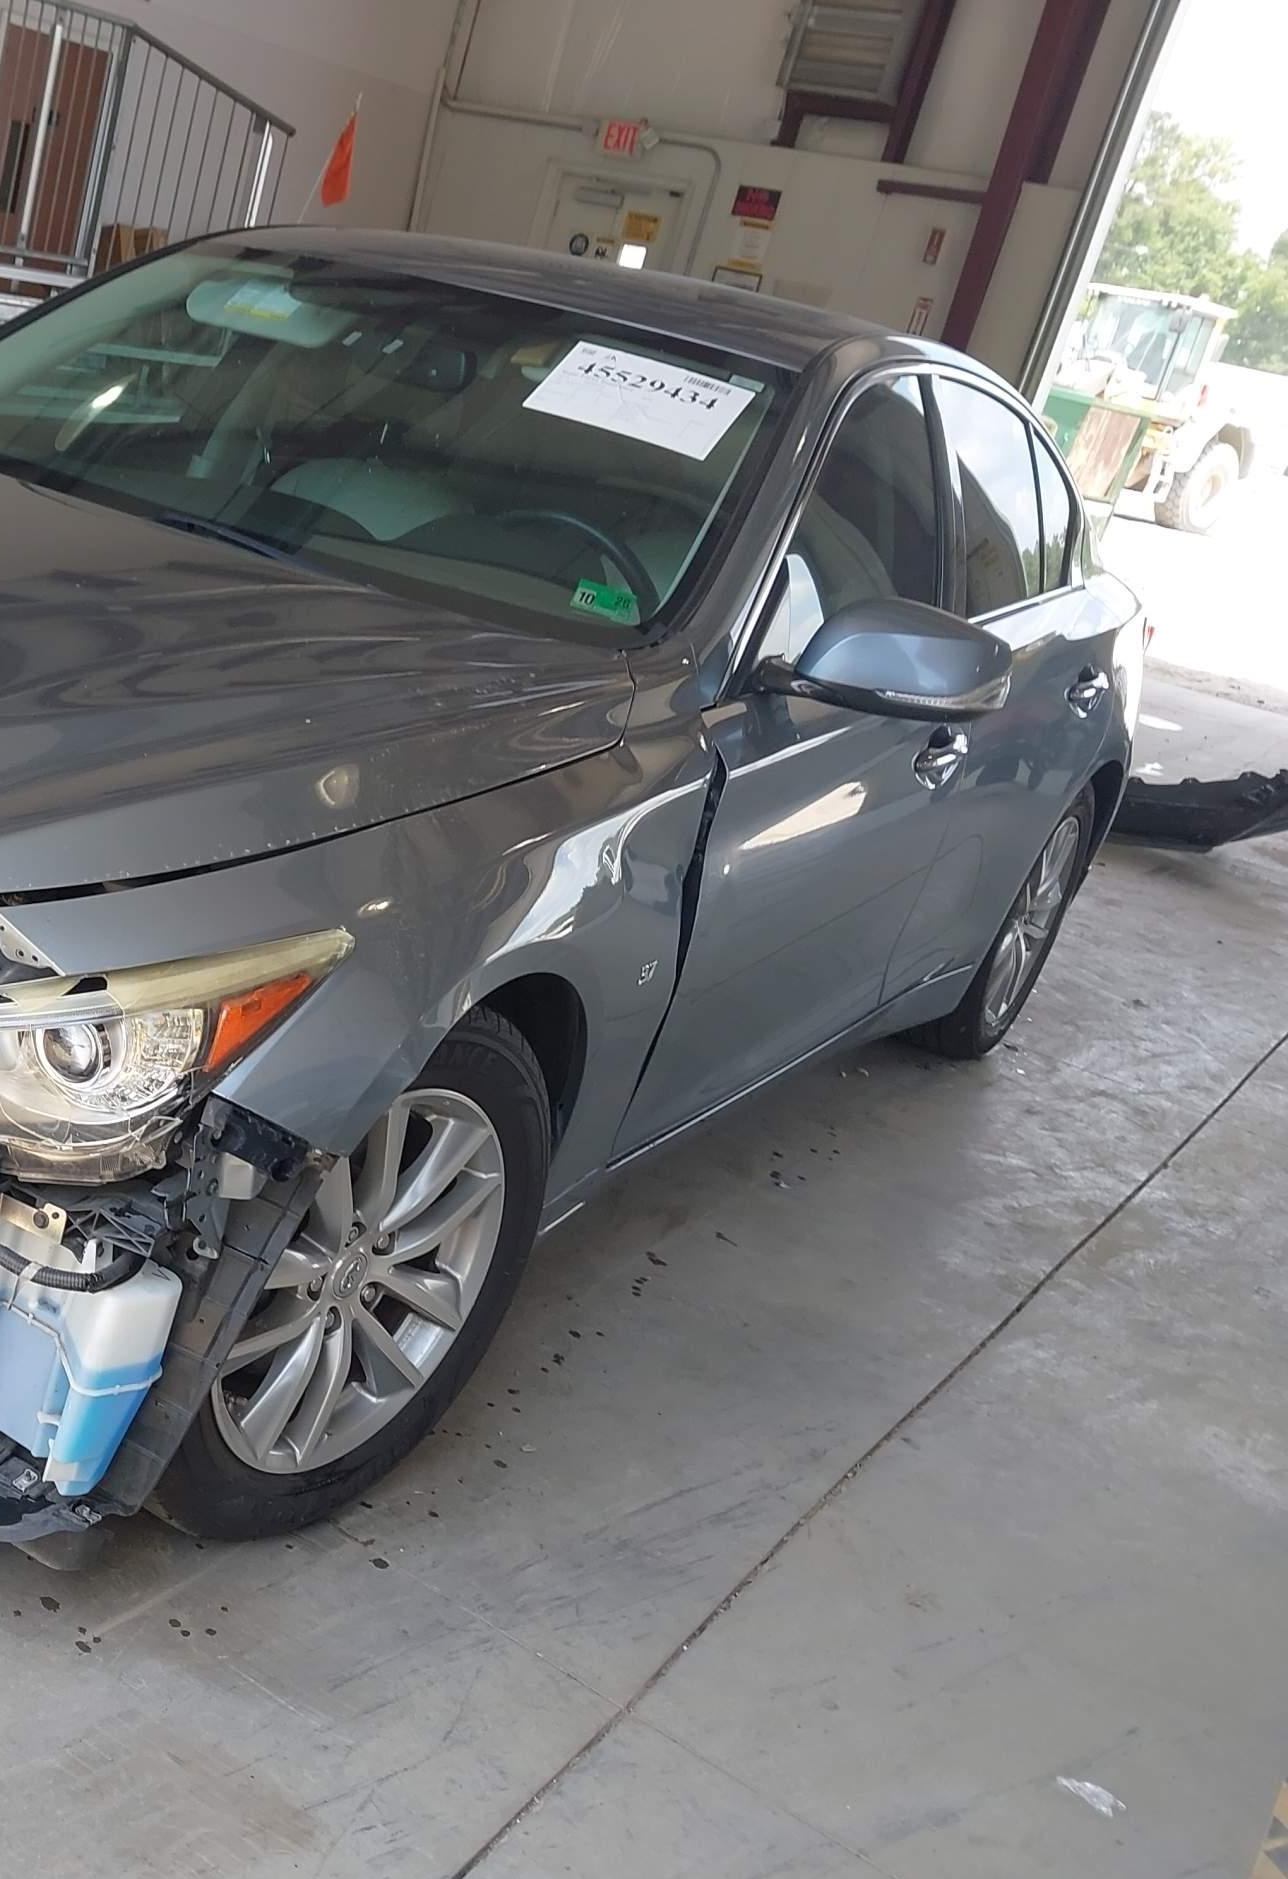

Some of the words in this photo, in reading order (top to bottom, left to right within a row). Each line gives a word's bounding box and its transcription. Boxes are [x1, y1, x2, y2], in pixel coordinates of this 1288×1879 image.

[604, 121, 639, 156] EXIT
[577, 361, 719, 411] 45529434
[579, 591, 595, 606] 10
